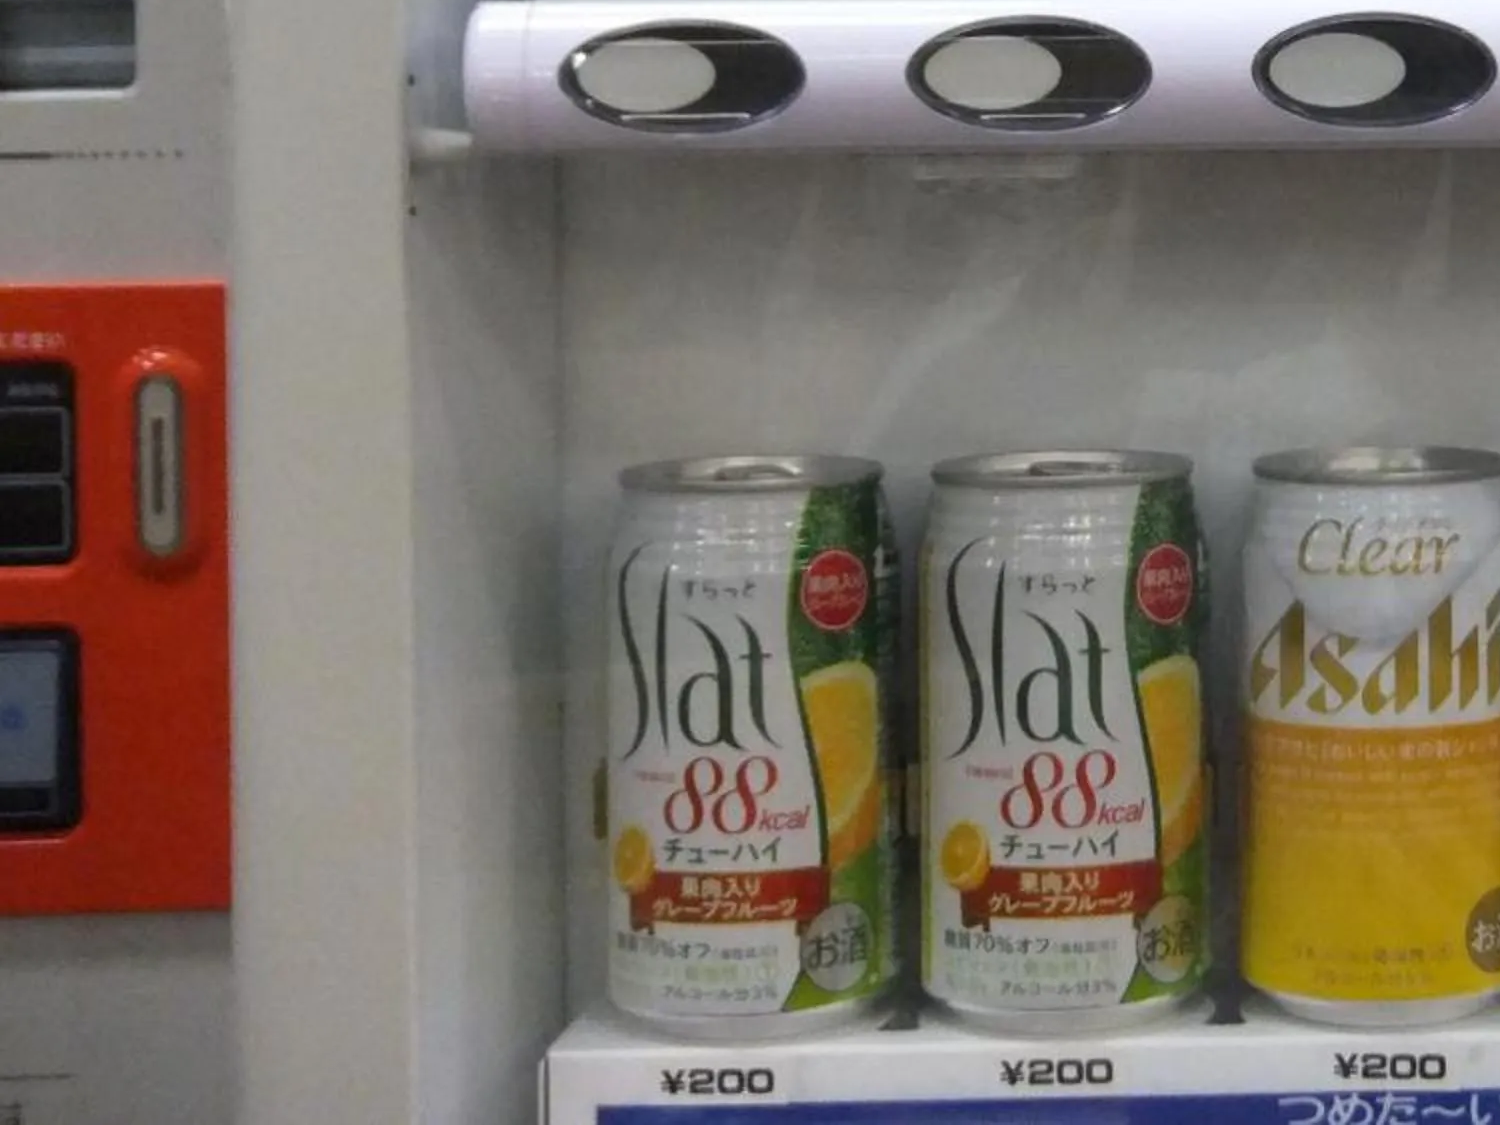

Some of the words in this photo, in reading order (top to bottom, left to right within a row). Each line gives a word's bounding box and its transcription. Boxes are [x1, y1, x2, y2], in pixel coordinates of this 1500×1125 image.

[1297, 516, 1461, 577] Clear
[663, 836, 782, 865] チューハイ
[1000, 829, 1120, 860] チューハイ
[987, 890, 1135, 915] グレープフルーツ
[1001, 1059, 1114, 1085] ¥200
[1333, 1053, 1447, 1080] ¥200
[661, 1068, 775, 1095] ¥200
